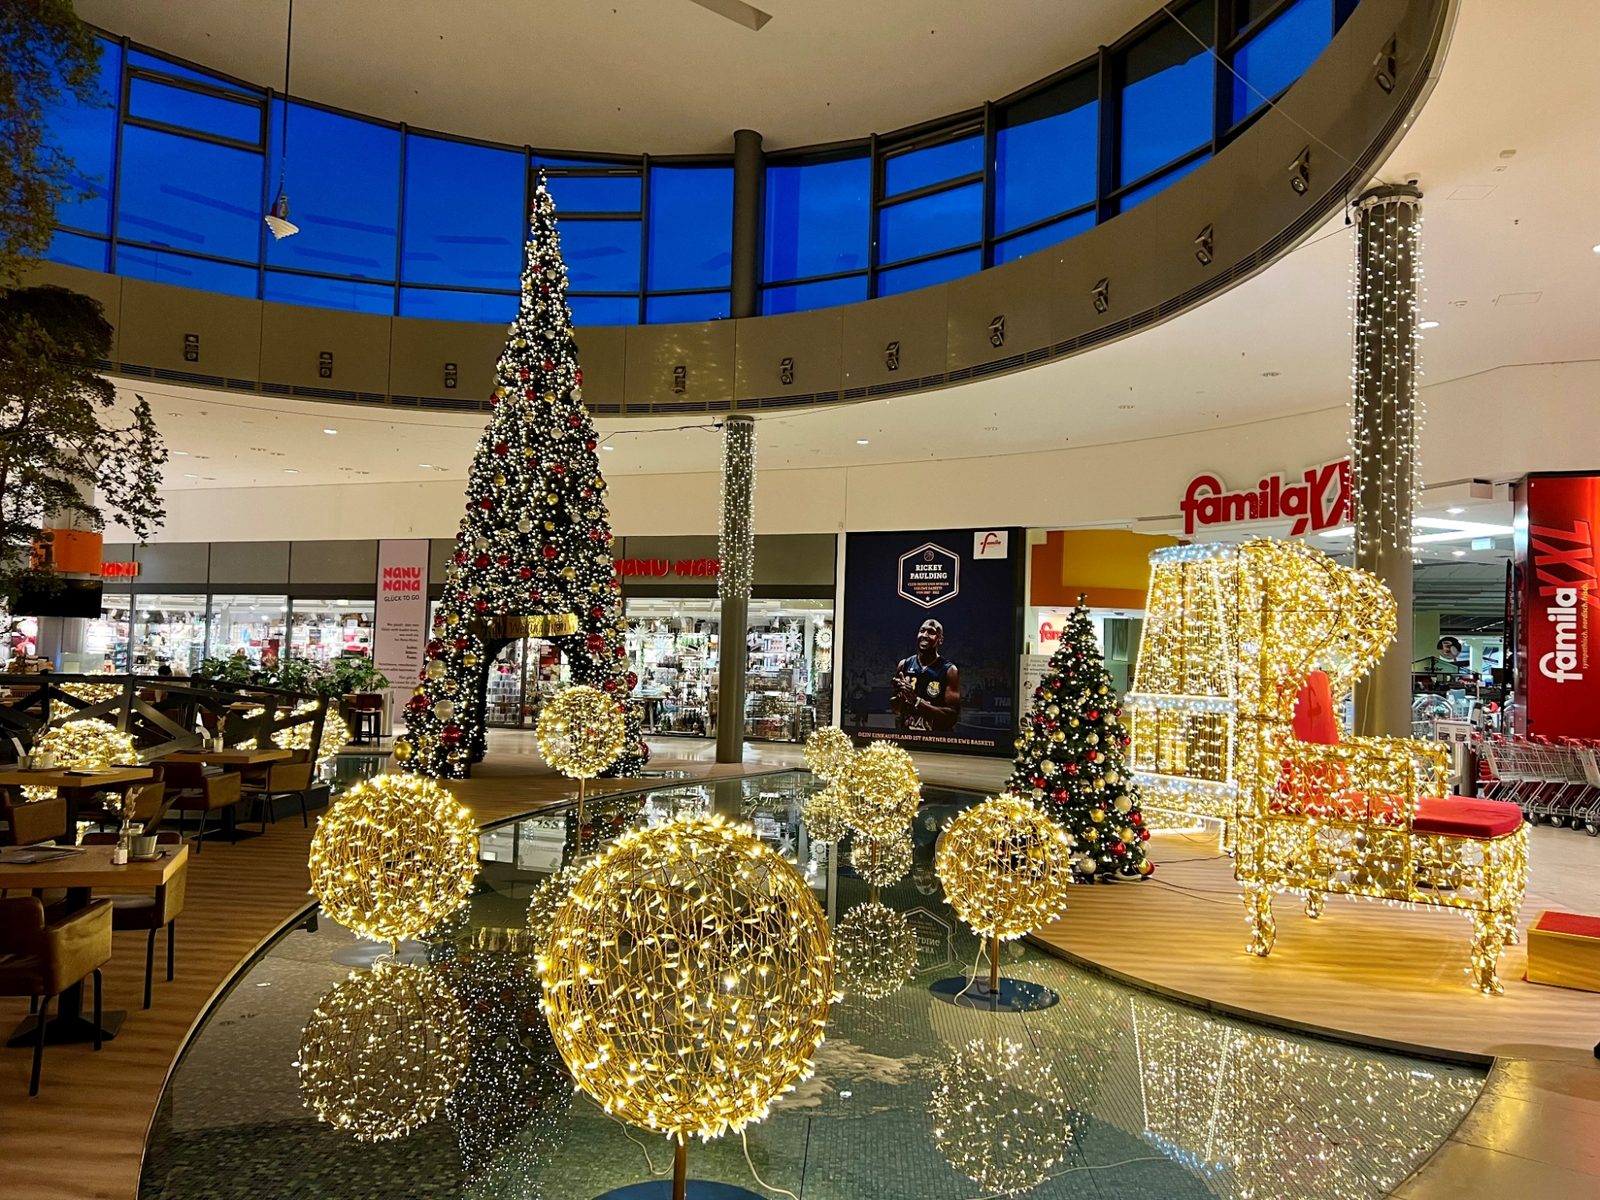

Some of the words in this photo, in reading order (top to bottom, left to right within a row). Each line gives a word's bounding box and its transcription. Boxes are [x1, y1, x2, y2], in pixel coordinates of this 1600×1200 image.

[383, 567, 421, 578] NANU
[910, 572, 948, 580] PAULDING
[383, 580, 421, 591] NANA
[384, 594, 401, 602] GLÜCK
[1539, 587, 1583, 683] famila
